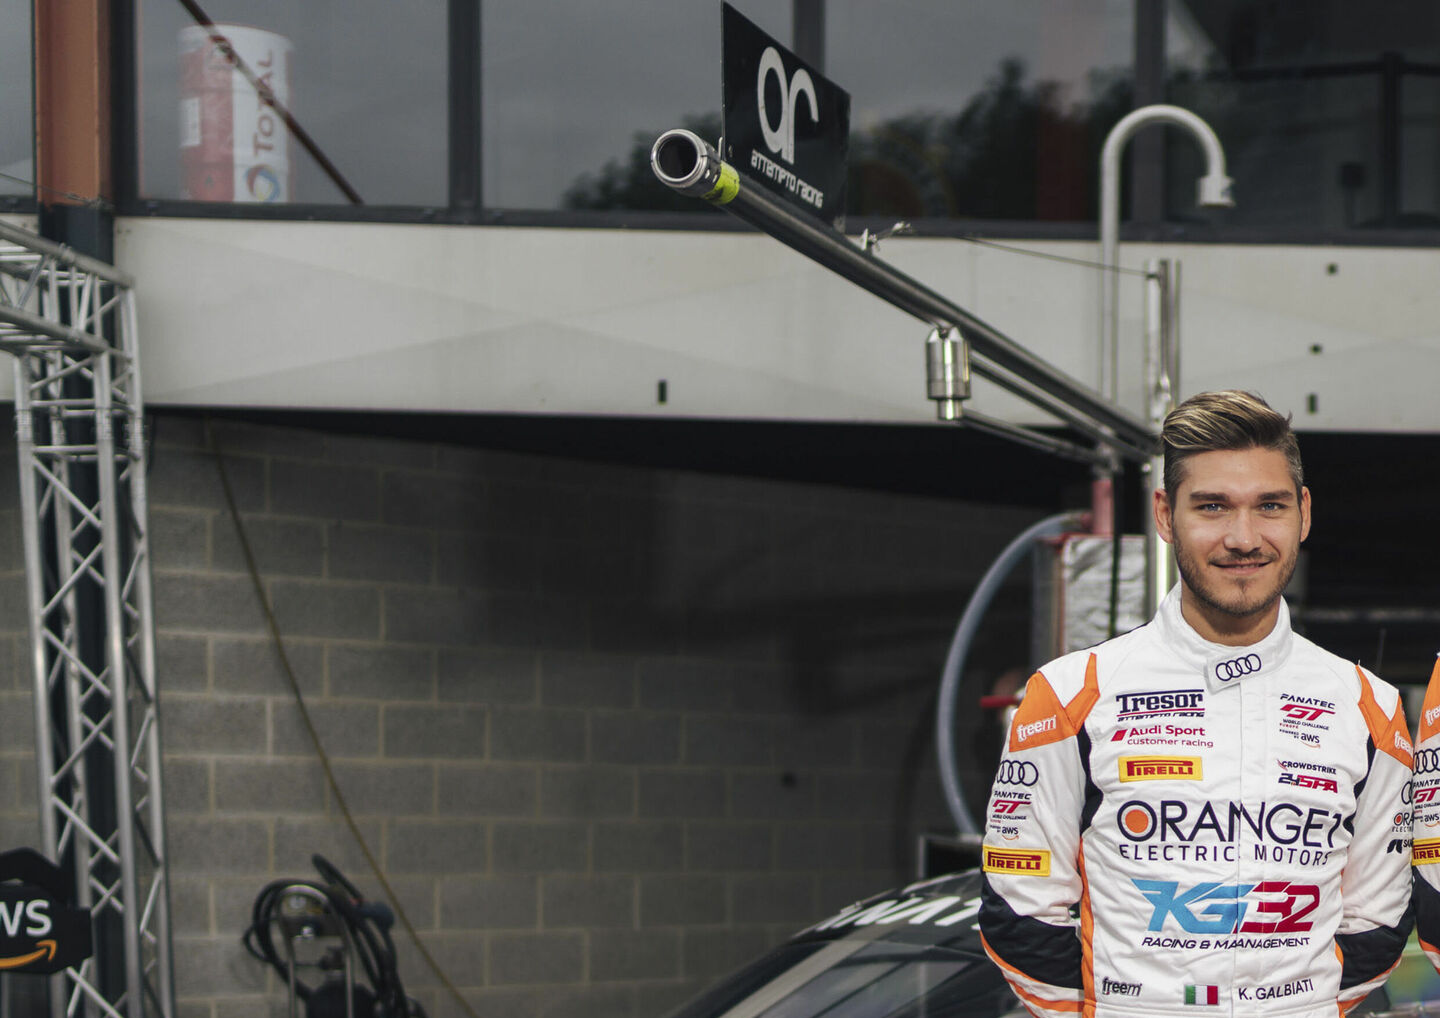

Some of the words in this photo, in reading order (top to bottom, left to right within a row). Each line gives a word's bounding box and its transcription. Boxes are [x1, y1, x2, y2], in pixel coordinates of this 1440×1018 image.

[1116, 689, 1205, 713] Tresor
[1280, 693, 1336, 710] FANATEC
[1016, 715, 1056, 743] freem
[1129, 725, 1162, 737] Audi
[1165, 724, 1206, 737] Sport
[1283, 718, 1301, 726] WORLD
[1301, 721, 1329, 731] CHALLENGE
[1127, 737, 1178, 746] customer
[1181, 739, 1214, 749] racing
[1301, 732, 1320, 744] aws
[1126, 760, 1194, 777] PIRELLI
[1281, 760, 1337, 775] CROWDSTRIKE
[1117, 800, 1342, 848] ORANGE1
[1424, 813, 1440, 823] aws
[1002, 825, 1019, 835] aws
[987, 851, 1042, 870] PIRELLI
[1118, 843, 1235, 862] ELECTRIC
[1254, 844, 1332, 866] MOTORS
[1141, 937, 1197, 949] RACING
[1102, 976, 1142, 996] freem
[1238, 987, 1253, 1000] K.
[1255, 978, 1314, 1000] GALBIATI
